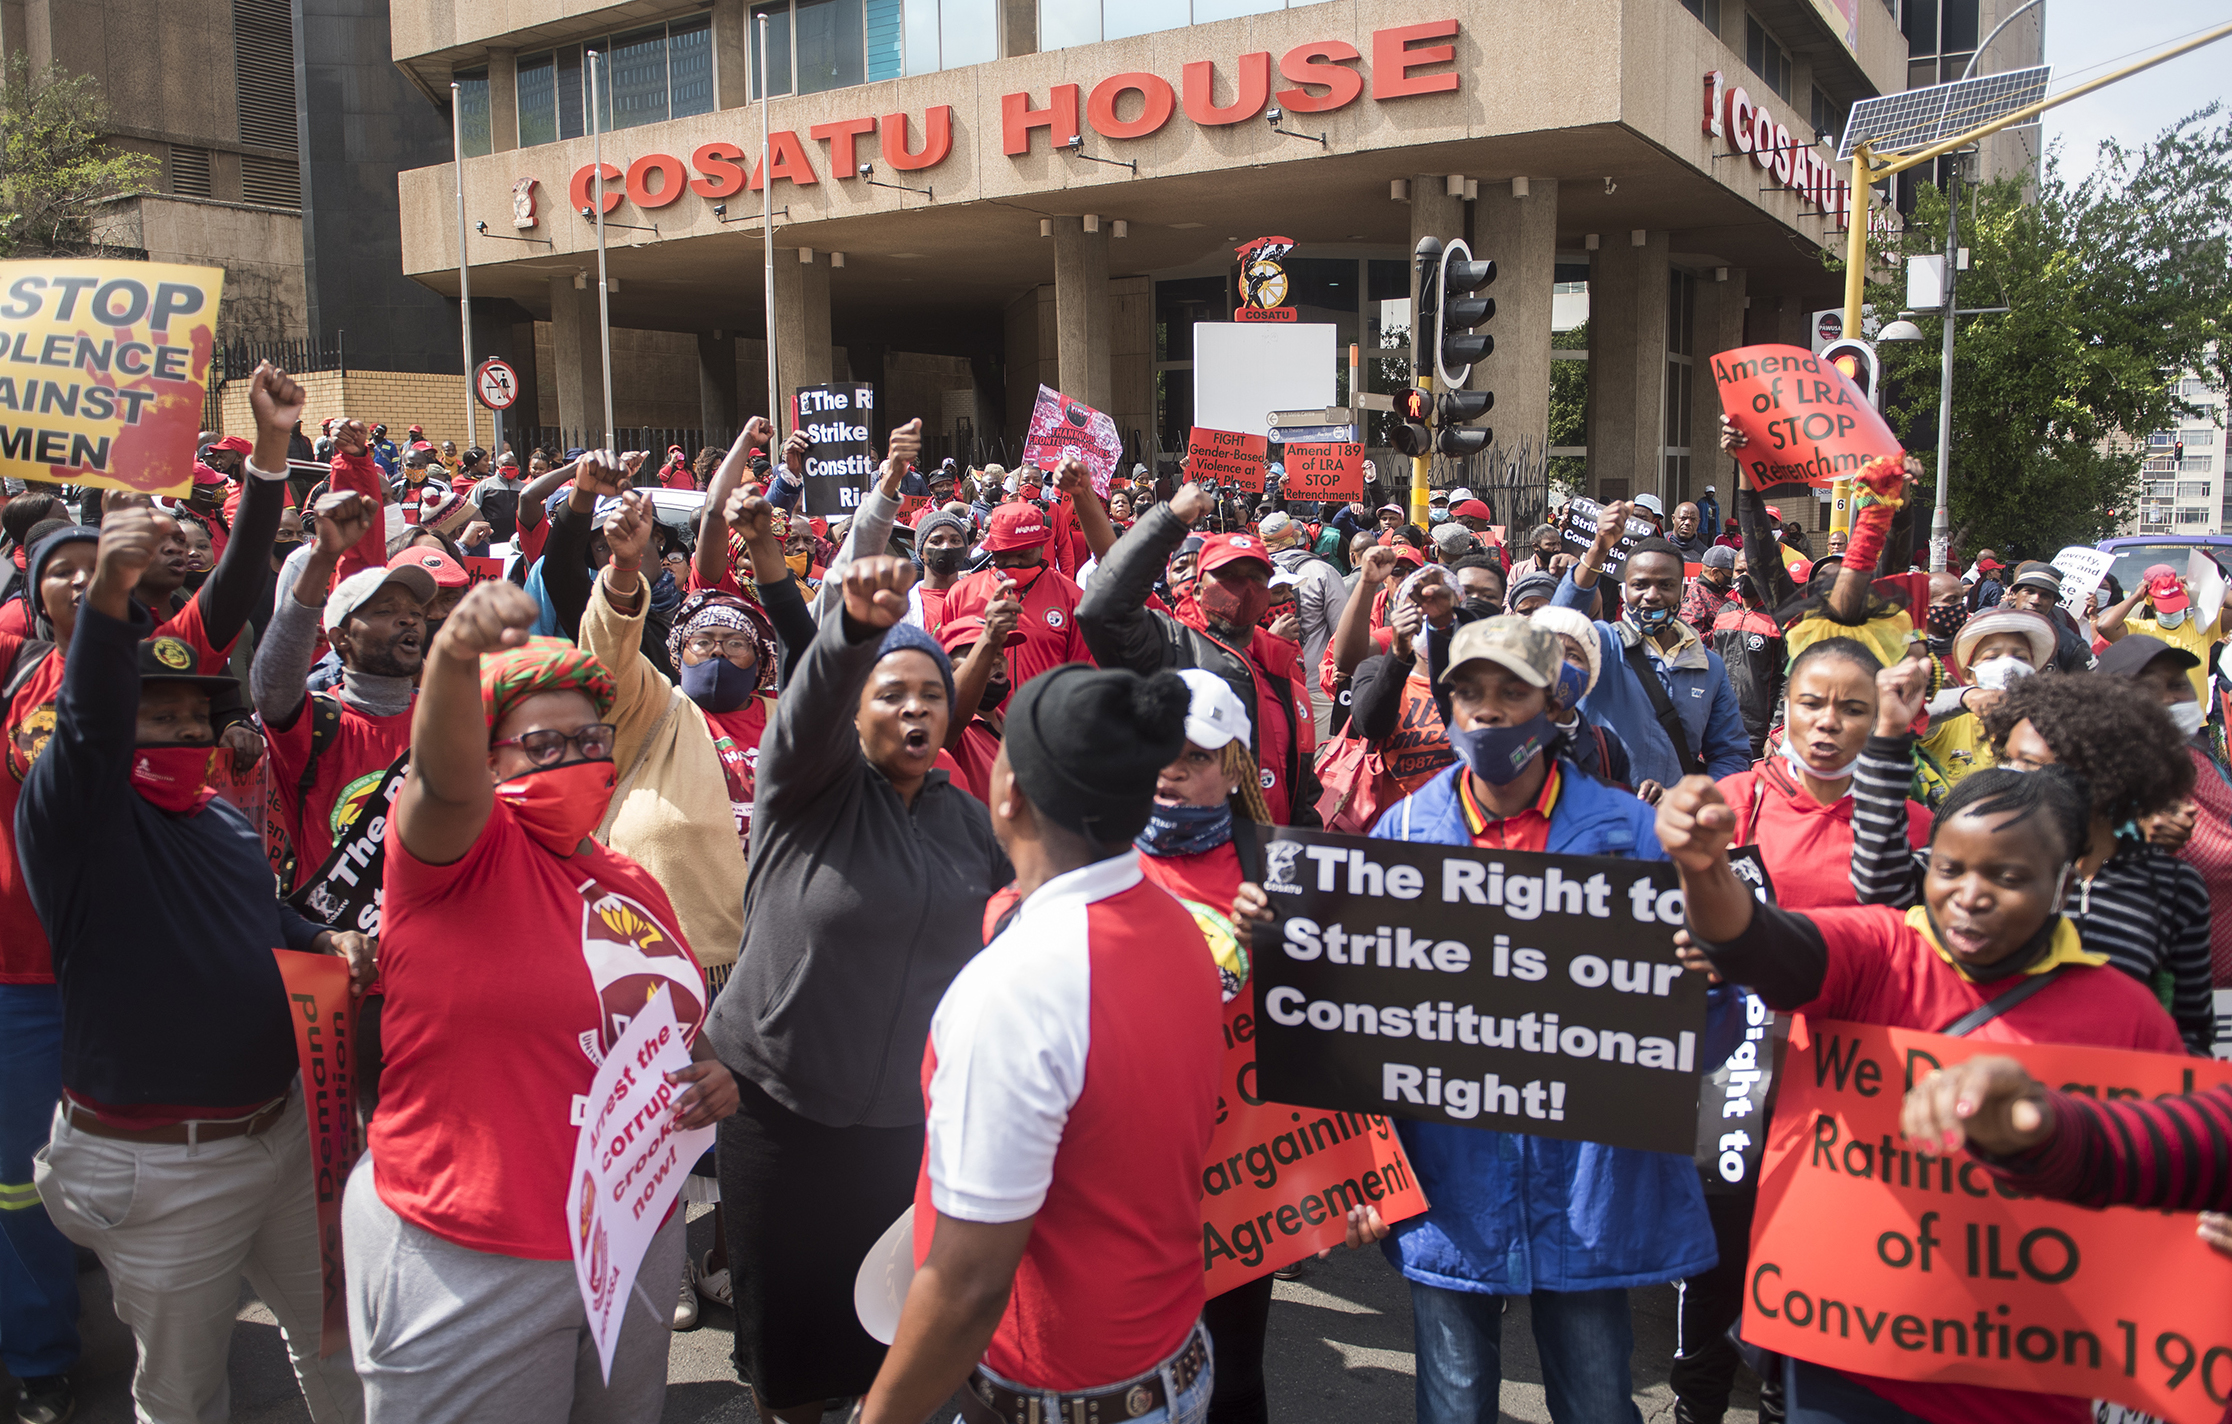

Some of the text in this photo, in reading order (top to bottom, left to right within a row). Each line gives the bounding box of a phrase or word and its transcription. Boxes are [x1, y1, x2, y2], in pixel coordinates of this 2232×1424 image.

[570, 18, 1460, 215] COSATU HOUSE
[1725, 87, 1836, 214] COSATU
[1, 275, 205, 331] STOP
[1246, 311, 1289, 319] COSATU
[1716, 355, 1819, 387] Amend
[811, 391, 848, 411] The
[1753, 377, 1783, 414] of
[1797, 380, 1860, 412] LRA
[808, 422, 868, 444] Strike
[1029, 435, 1077, 446] FRONTLINE
[1051, 427, 1096, 443] THANK YOU
[1213, 433, 1246, 446] FIGHT
[1287, 444, 1361, 456] Amend 189
[1768, 413, 1856, 451] STOP
[1190, 444, 1264, 462] Gender-Based
[1197, 458, 1256, 475] Violence at
[1302, 458, 1344, 471] of LRA
[1751, 445, 1873, 487] Retrenchme
[1191, 471, 1220, 484] Wok
[1286, 487, 1360, 501] Retrenchments
[1306, 475, 1340, 486] STOP
[1837, 500, 1844, 509] 6
[1572, 514, 1639, 547] Strik ou
[1638, 524, 1651, 536] to
[2077, 565, 2100, 576] and
[1400, 755, 1435, 772] 1987
[327, 815, 386, 887] The
[1262, 880, 1303, 895] COSATU
[1304, 844, 1686, 925] The Right to
[325, 898, 350, 925] COSATU
[1282, 916, 1683, 997] Strike is our
[1264, 985, 1697, 1073] Constitutional
[1813, 1032, 1883, 1099] We
[332, 1012, 349, 1184] fication
[590, 1064, 637, 1155] Arrest
[637, 1024, 671, 1069] the
[1382, 1061, 1567, 1122] Right!
[602, 1070, 680, 1174] corrupt
[291, 994, 338, 1311] We Demand
[1200, 1112, 1389, 1201] argaining
[1718, 1129, 1752, 1184] to
[632, 1144, 678, 1222] now!
[1203, 1150, 1411, 1272] Agreement
[1876, 1211, 2080, 1285] of ILO
[1751, 1262, 2101, 1369] Convention
